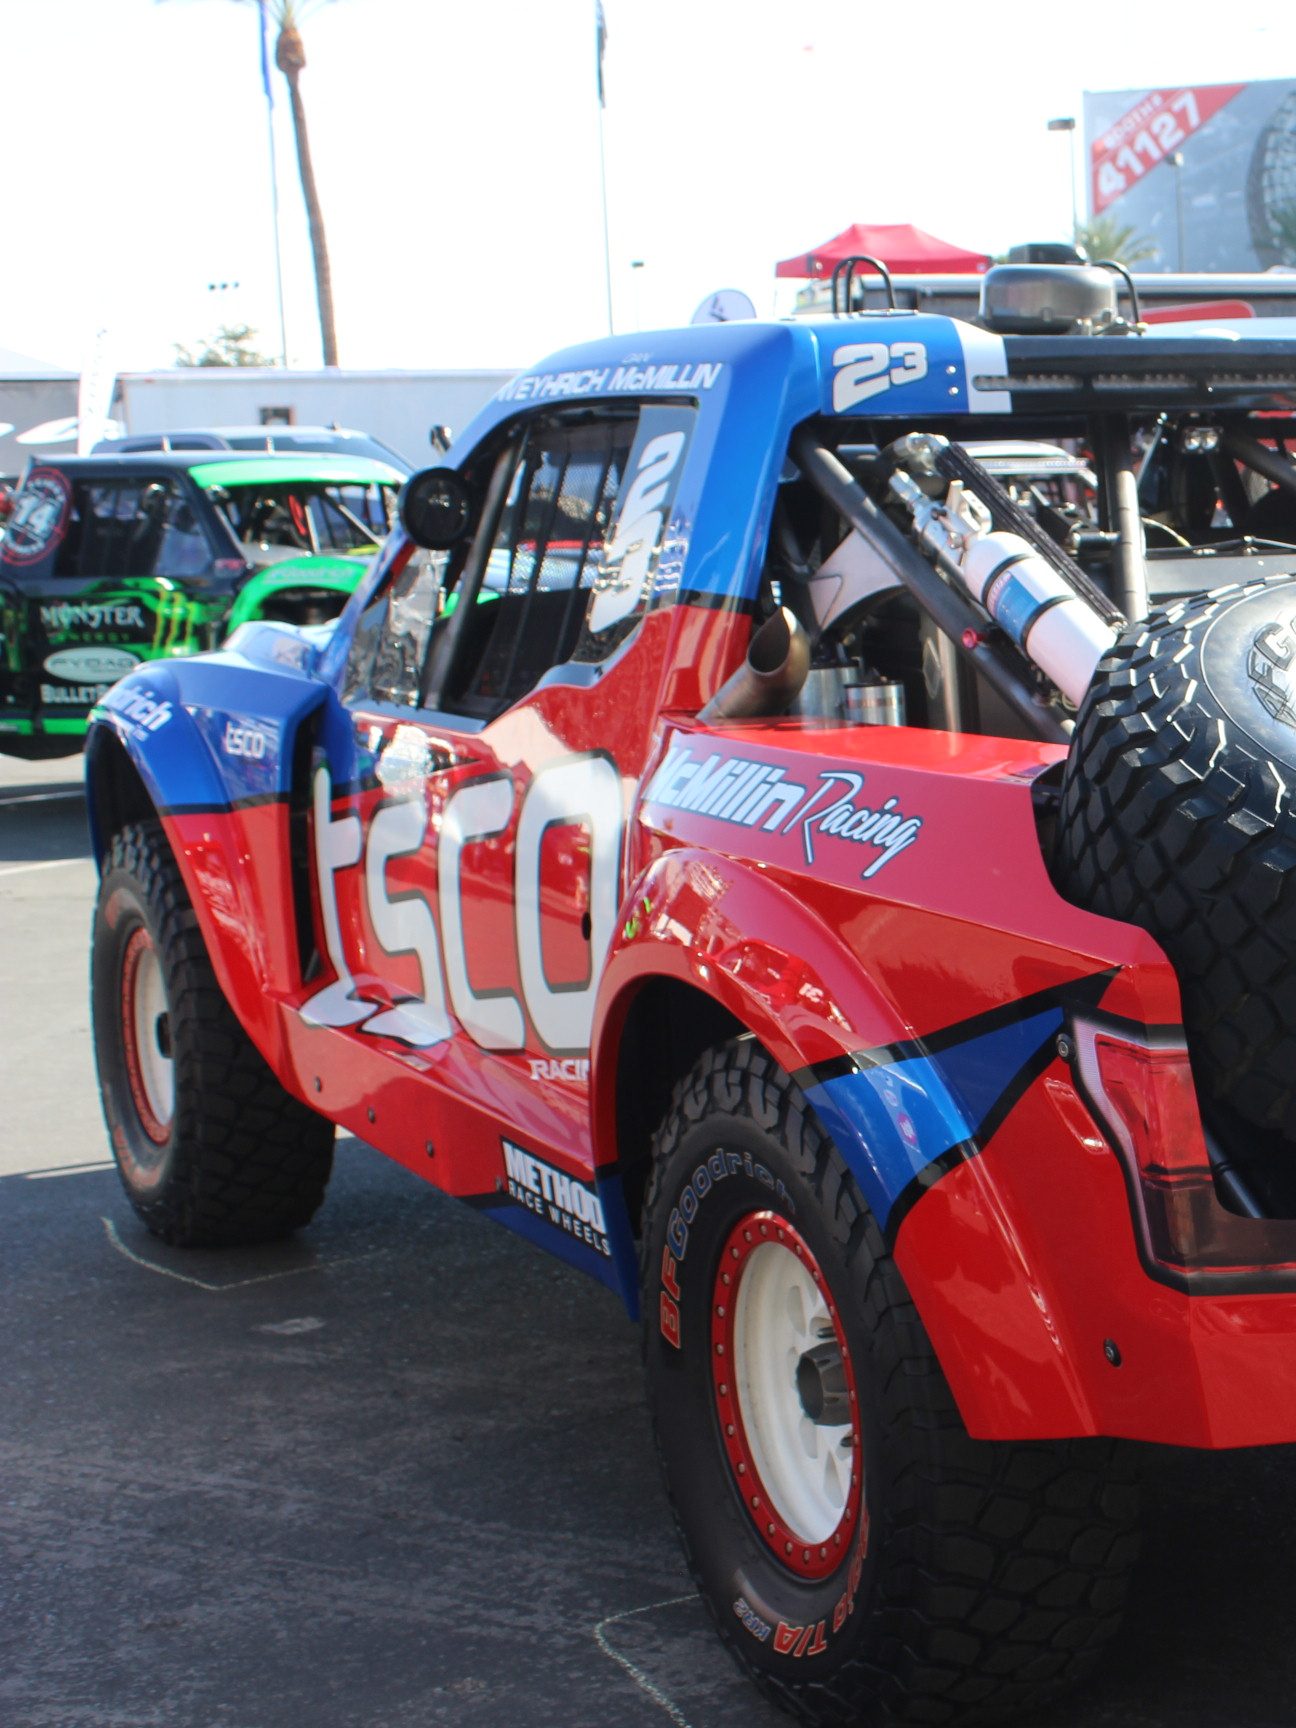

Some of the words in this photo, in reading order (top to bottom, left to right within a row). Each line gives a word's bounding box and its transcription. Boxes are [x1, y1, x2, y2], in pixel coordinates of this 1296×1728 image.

[1097, 89, 1200, 196] 41127
[832, 342, 927, 414] 23
[16, 496, 56, 540] 14
[40, 603, 146, 629] MONSTER
[782, 770, 922, 879] Racing
[502, 1140, 607, 1235] METHOD
[508, 1179, 543, 1215] RACE
[548, 1204, 611, 1256] WHEELS
[660, 1147, 796, 1349] BFGoodrich
[773, 1620, 827, 1657] T/A
